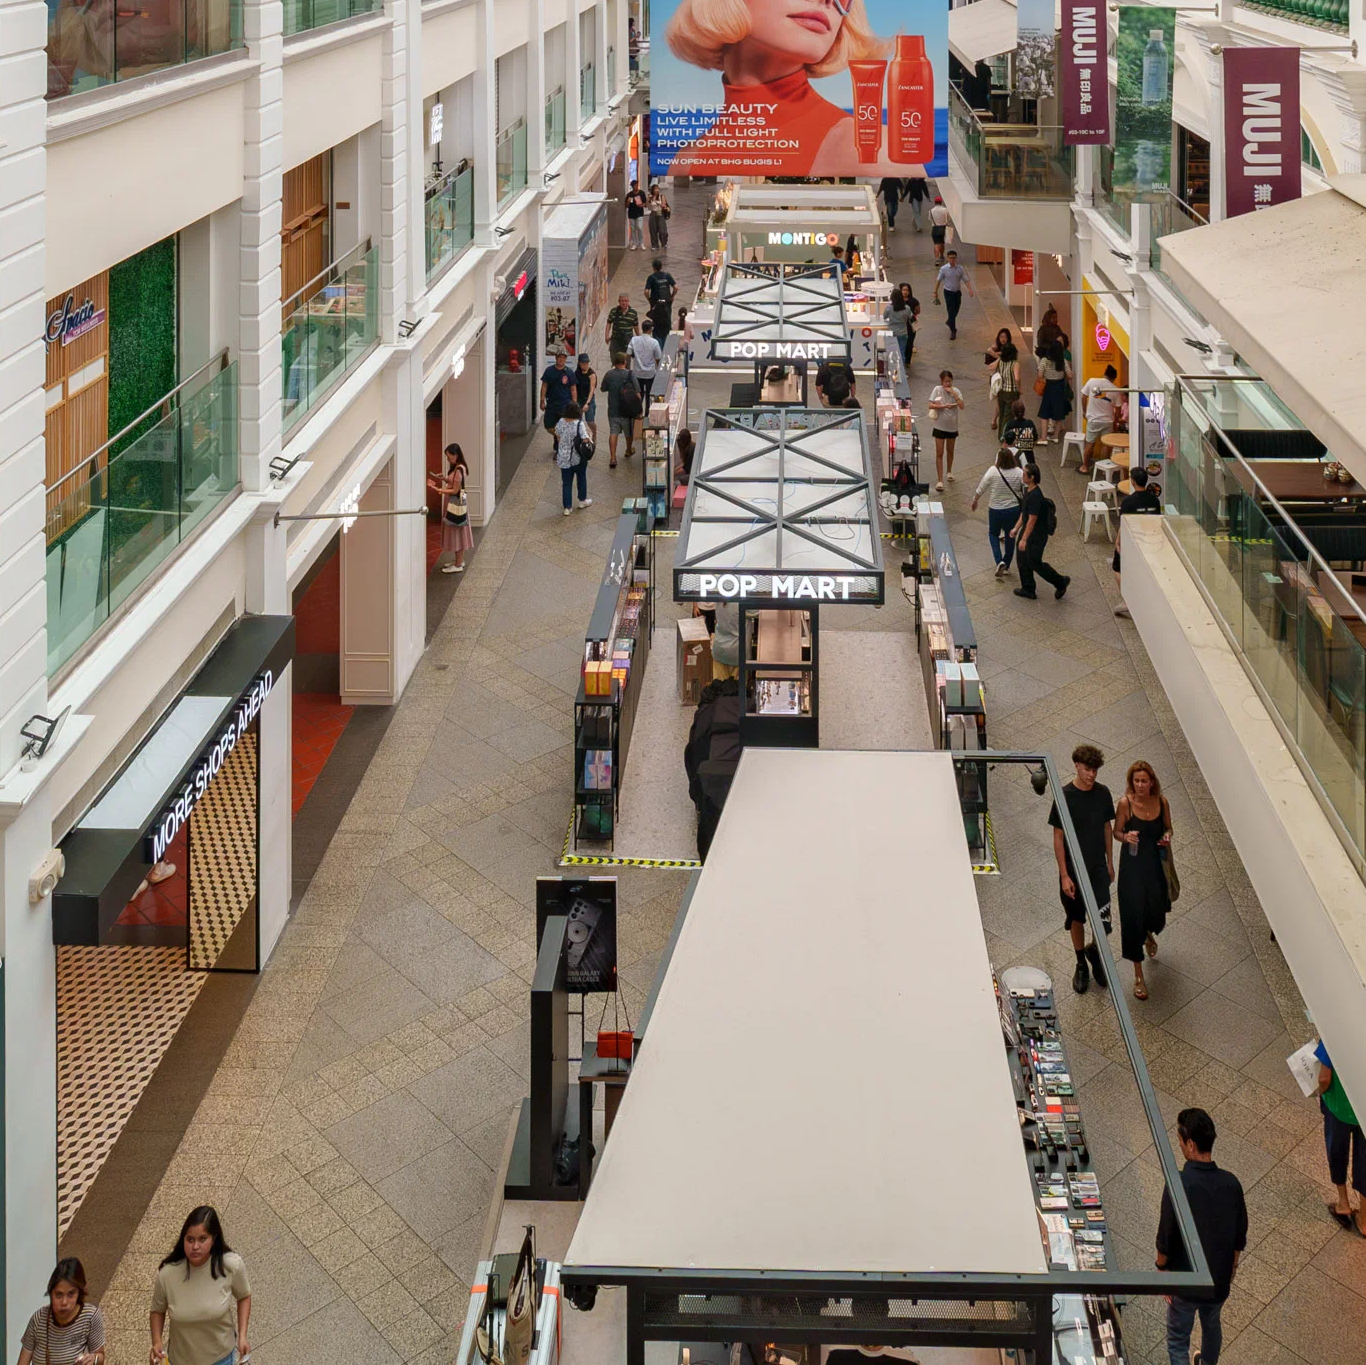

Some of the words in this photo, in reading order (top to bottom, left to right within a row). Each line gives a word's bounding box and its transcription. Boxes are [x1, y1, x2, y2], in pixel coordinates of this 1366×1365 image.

[1072, 7, 1097, 65] MUJI
[657, 104, 696, 114] SUN
[702, 104, 778, 114] BEAUTY
[858, 106, 877, 120] 50
[657, 117, 688, 125] LIVE
[691, 117, 766, 125] LIMITLESS
[901, 112, 921, 127] 50
[657, 128, 692, 136] WITH
[696, 128, 732, 136] FULL
[736, 128, 778, 137] LIGHT
[1242, 83, 1282, 177] MUJI
[657, 139, 799, 148] PHOTOPROTECTION
[768, 232, 840, 246] MONTIGO
[730, 342, 770, 358] POP
[776, 342, 832, 359] MART
[700, 574, 757, 597] POP
[771, 575, 856, 599] MART
[153, 783, 194, 864] MORE
[194, 723, 236, 799] SHOPS
[237, 669, 274, 740] AHEAD
